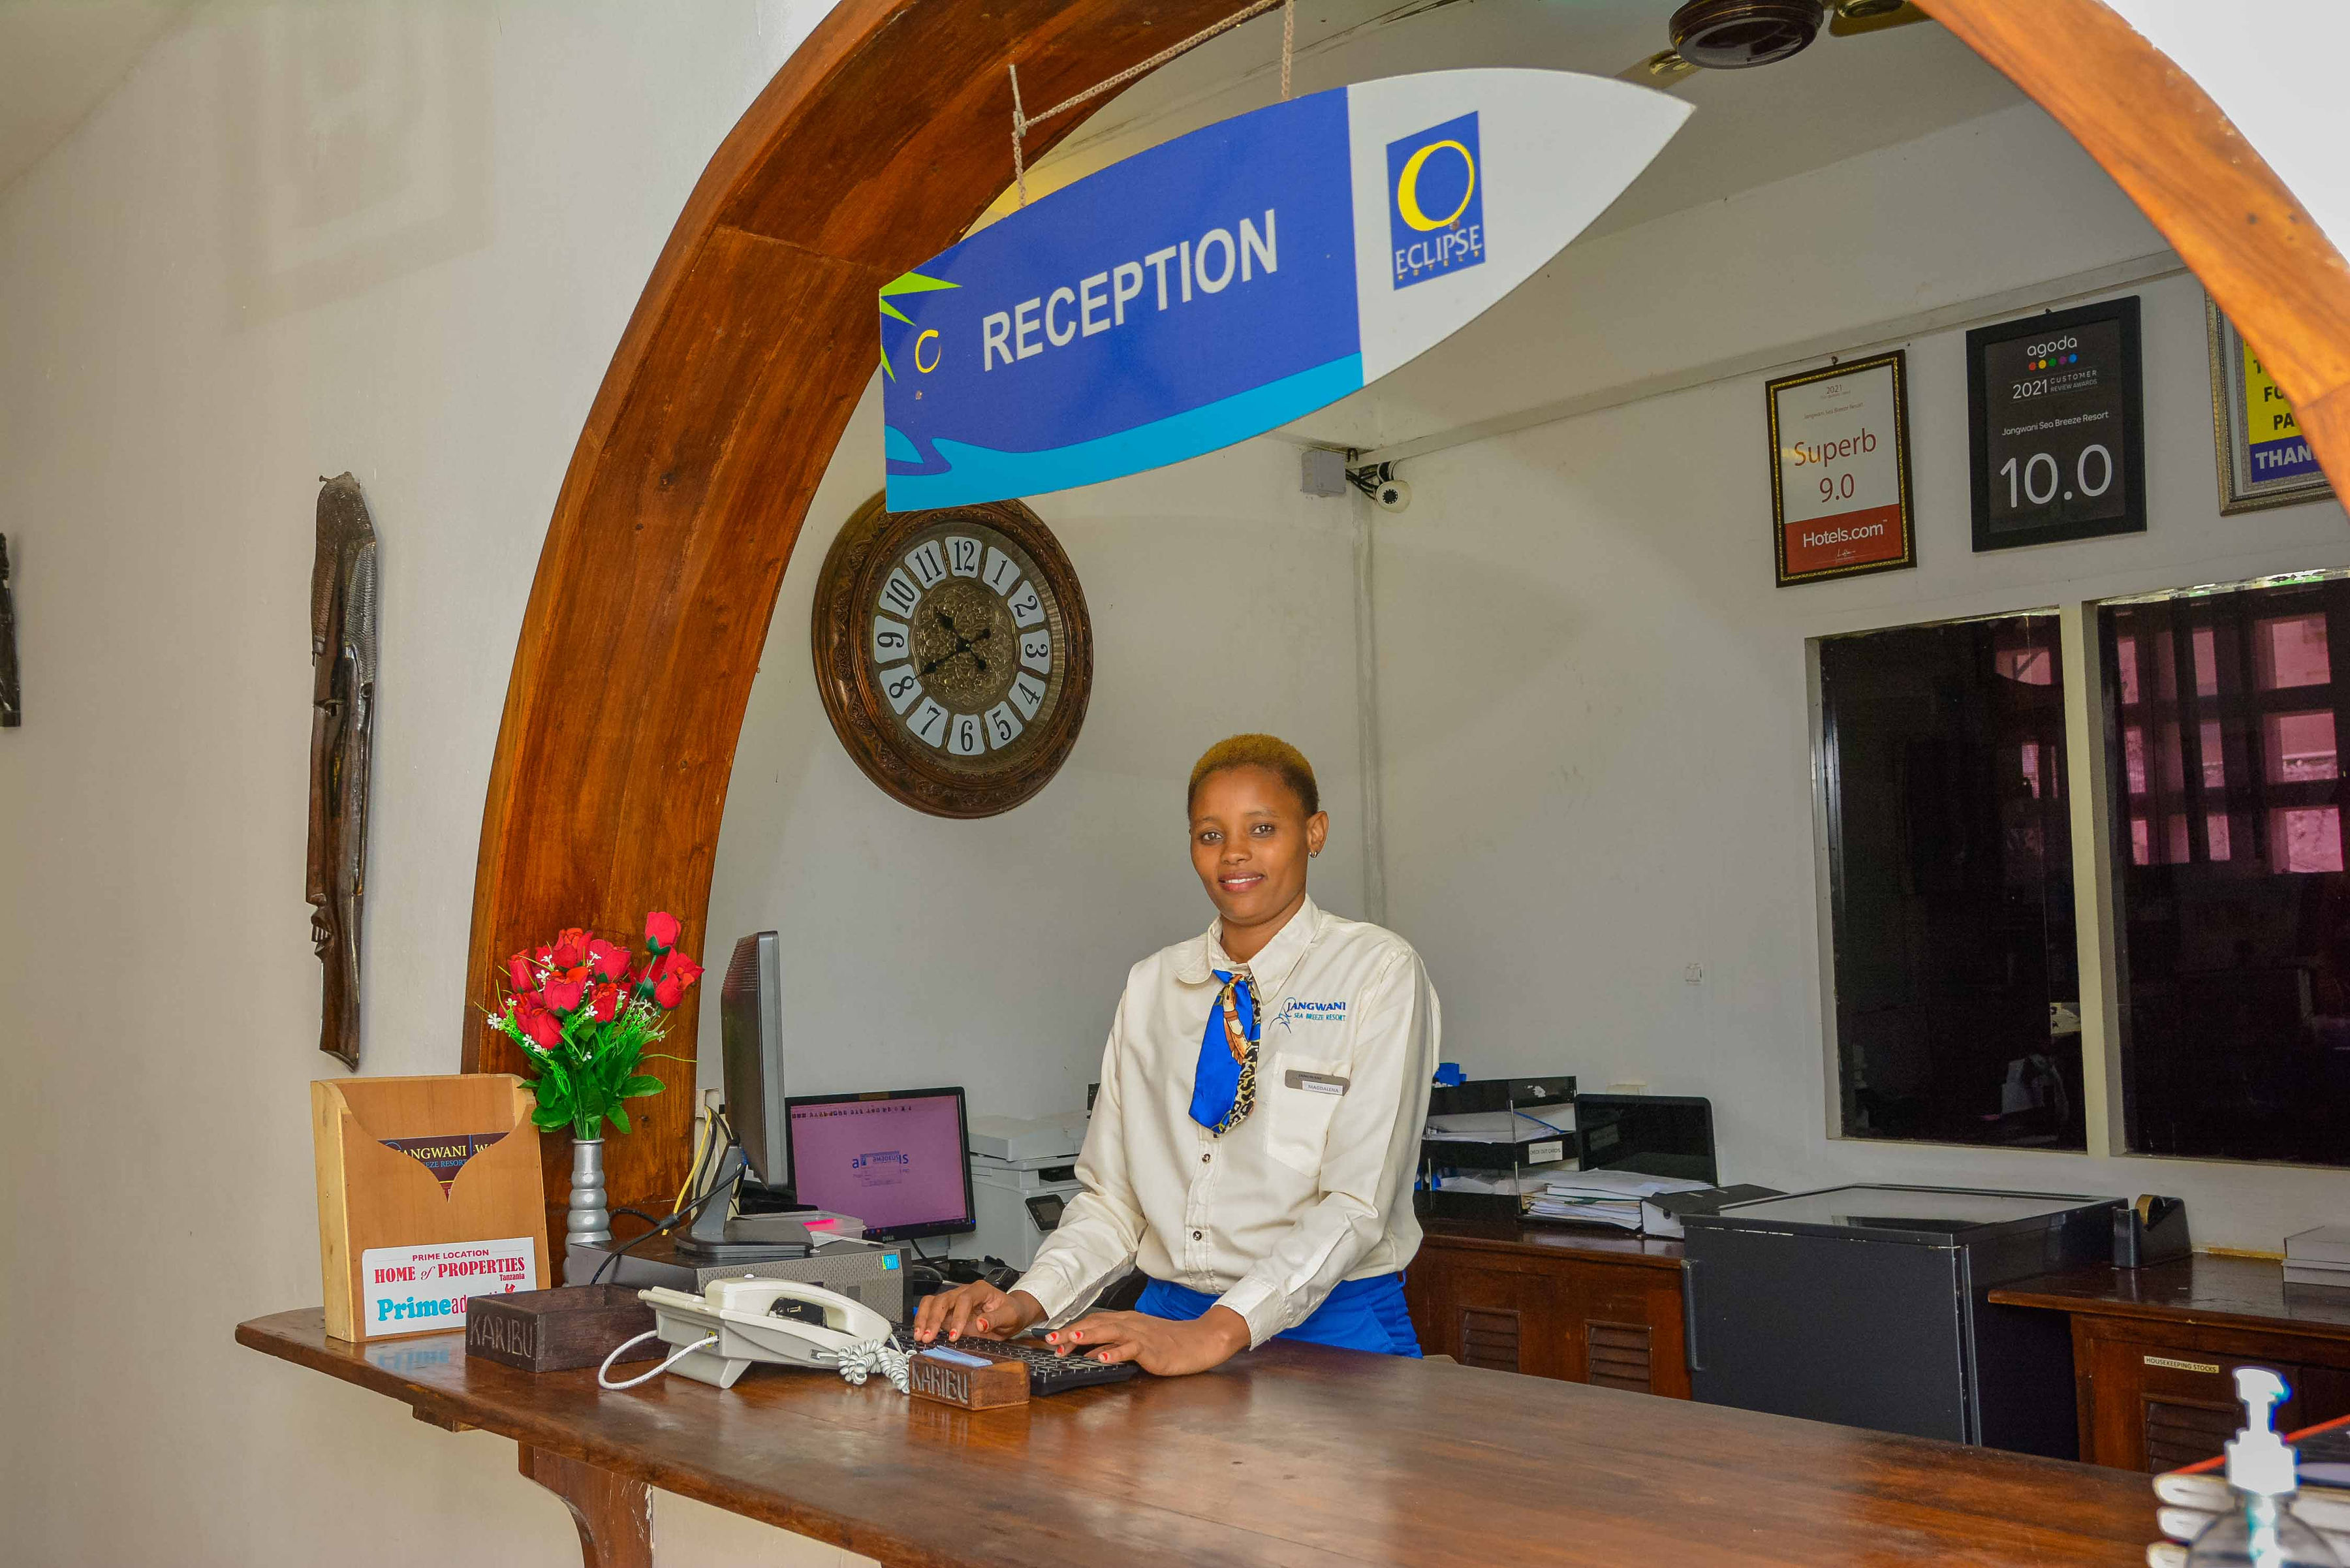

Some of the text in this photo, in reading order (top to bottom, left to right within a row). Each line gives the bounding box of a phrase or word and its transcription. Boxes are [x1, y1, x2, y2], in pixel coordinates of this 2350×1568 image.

[1396, 225, 1482, 274] ECLIPSE
[983, 209, 1277, 372] RECEPTION
[2027, 335, 2078, 358] agoda
[1826, 384, 1842, 394] 2021
[2013, 370, 2097, 400] 2021 CUSTOMER
[2050, 379, 2098, 392] REVIEW AWARDS
[2001, 411, 2110, 436] Jangwani Sea Breeze Resort
[2273, 413, 2296, 431] PA
[1794, 428, 1877, 467] Superb
[2255, 444, 2316, 469] THAN
[1819, 473, 1855, 503] 9.0
[1999, 444, 2112, 509] 10.0
[1803, 522, 1885, 548] Hotels.com
[915, 546, 943, 584] 11
[954, 540, 975, 572] 12
[992, 559, 1009, 586] 1
[886, 578, 915, 613] 10
[1014, 595, 1038, 618] 2
[877, 632, 905, 648] 9
[1025, 643, 1048, 659] 3
[889, 676, 915, 698] 8
[1018, 682, 1041, 706] 4
[920, 705, 941, 736] 7
[992, 710, 1012, 741] 5
[960, 719, 973, 752] 6
[1286, 1001, 1346, 1012] JANGWANI
[1308, 1084, 1339, 1093] MAGDALENA
[398, 1145, 467, 1159] ANGWANI
[412, 1249, 490, 1262] PRIME LOCATION
[374, 1257, 525, 1284] HOME of PROPERTIES
[499, 1273, 525, 1281] Tanzania
[377, 1294, 467, 1321] Primead
[470, 1313, 533, 1358] KARIBU
[2146, 1357, 2217, 1373] HOUSEKEEPING STOCKS
[912, 1363, 969, 1404] KARIBU
